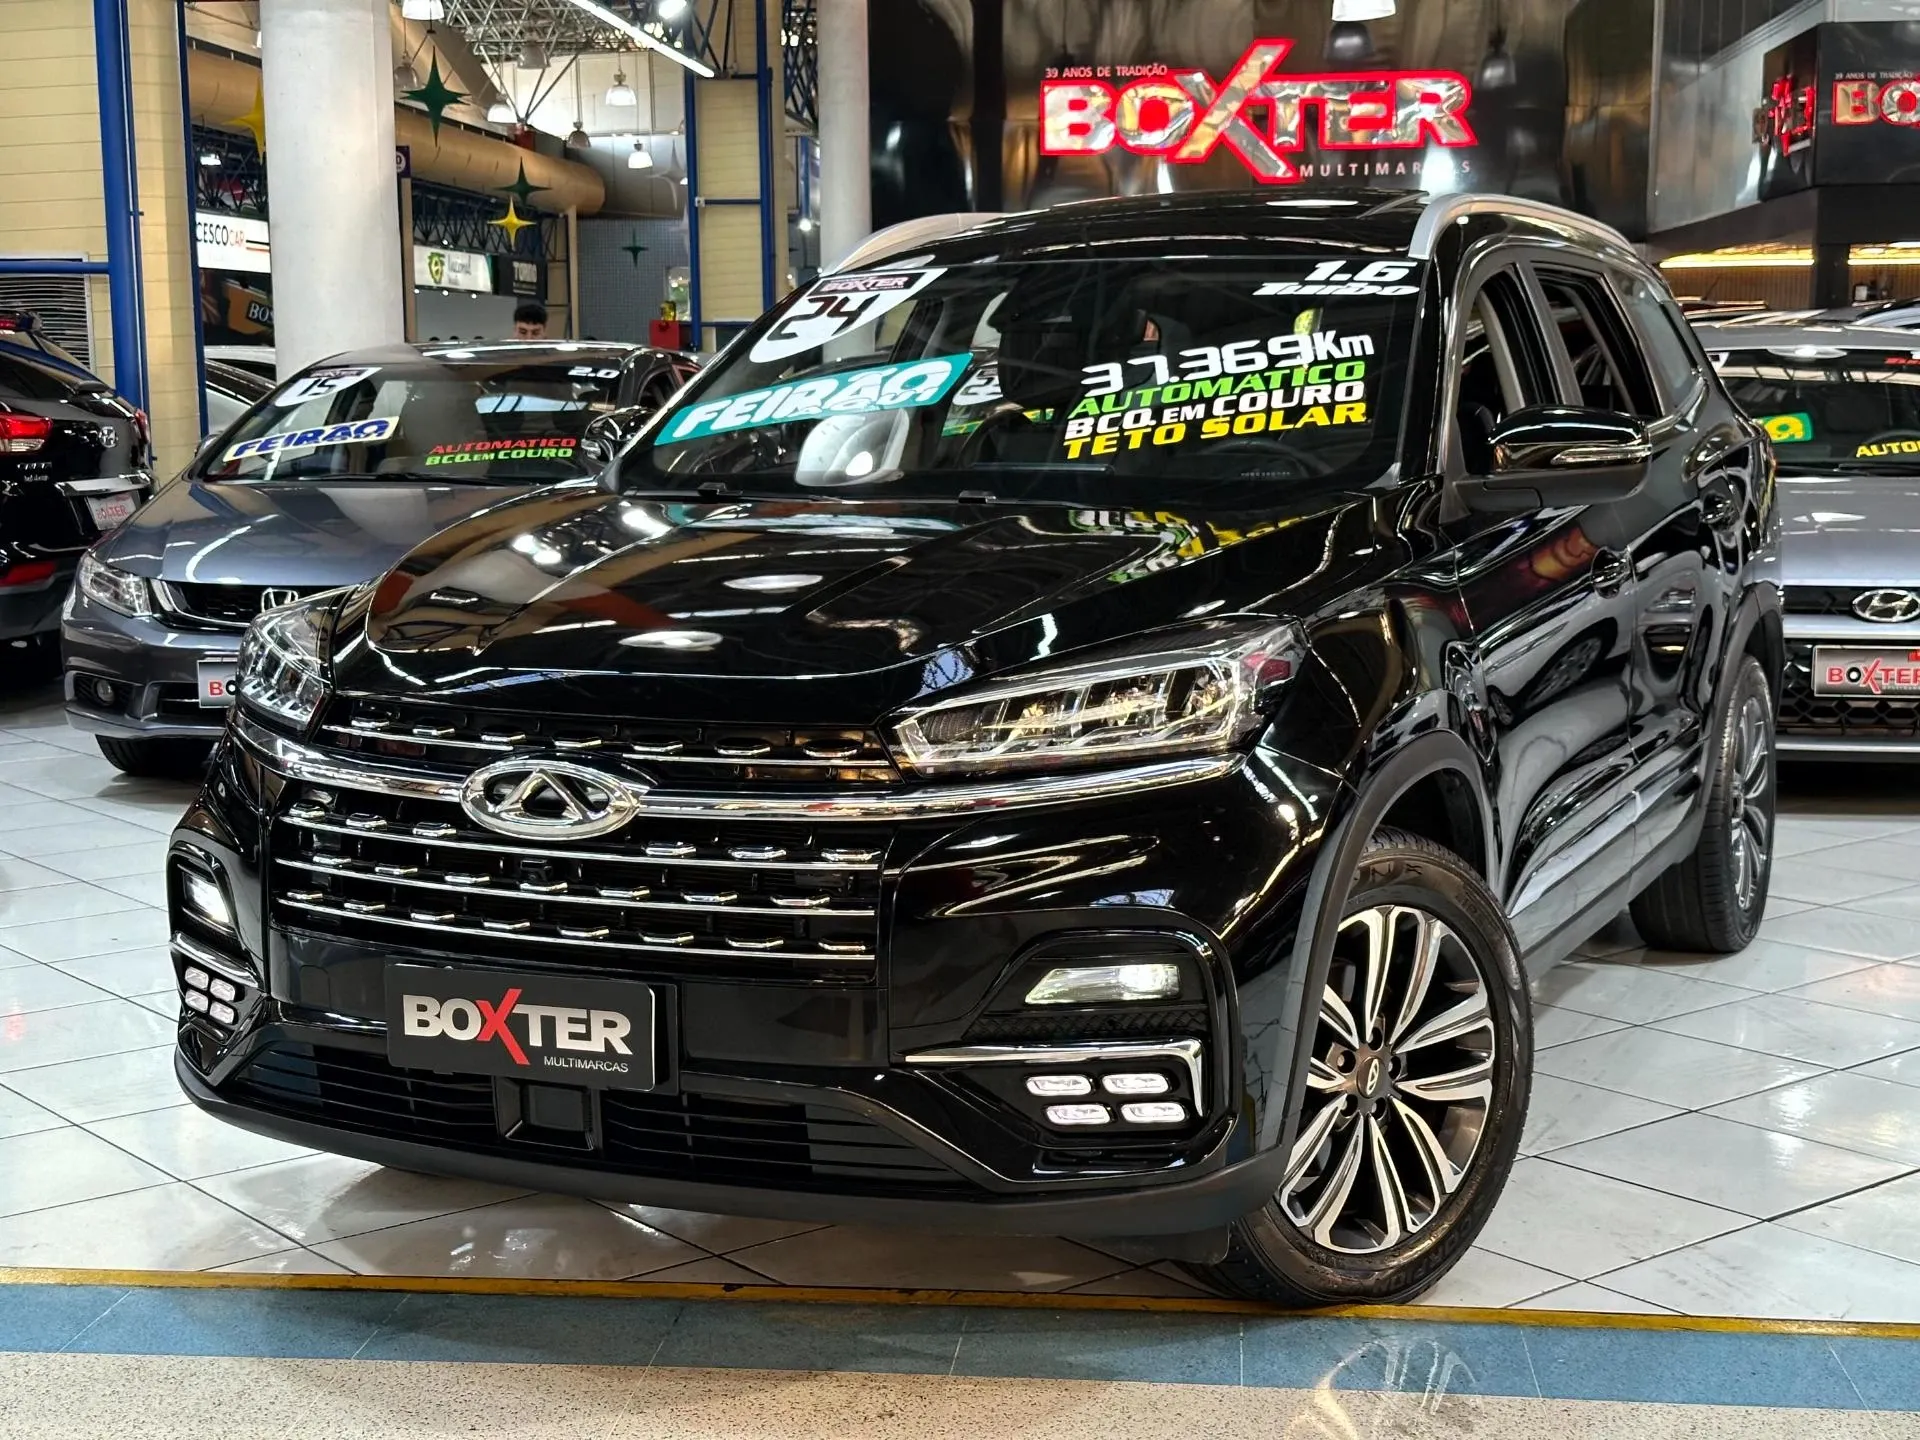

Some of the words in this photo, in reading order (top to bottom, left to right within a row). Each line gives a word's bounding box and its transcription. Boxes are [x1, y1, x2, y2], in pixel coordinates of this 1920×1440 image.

[1045, 67, 1059, 78] 39
[1063, 66, 1093, 77] ANOS
[1097, 66, 1111, 77] DE
[1116, 62, 1168, 78] TRADIÇÃO
[1040, 38, 1478, 184] BOXTER
[1300, 160, 1471, 177] MULTIMARS
[1305, 260, 1418, 281] 1.6
[820, 276, 909, 292] BOXTER
[1252, 282, 1420, 296] Turbo
[767, 294, 880, 341] 24
[568, 366, 620, 379] 2.0
[1161, 403, 1205, 424] EM
[1212, 380, 1365, 417] COURO
[1063, 422, 1187, 460] TETO
[1200, 401, 1368, 440] SOLAR
[473, 453, 495, 461] EM
[499, 448, 574, 460] COURO
[403, 988, 633, 1066] BOXTER
[544, 1055, 629, 1073] MULTIMARCAS
